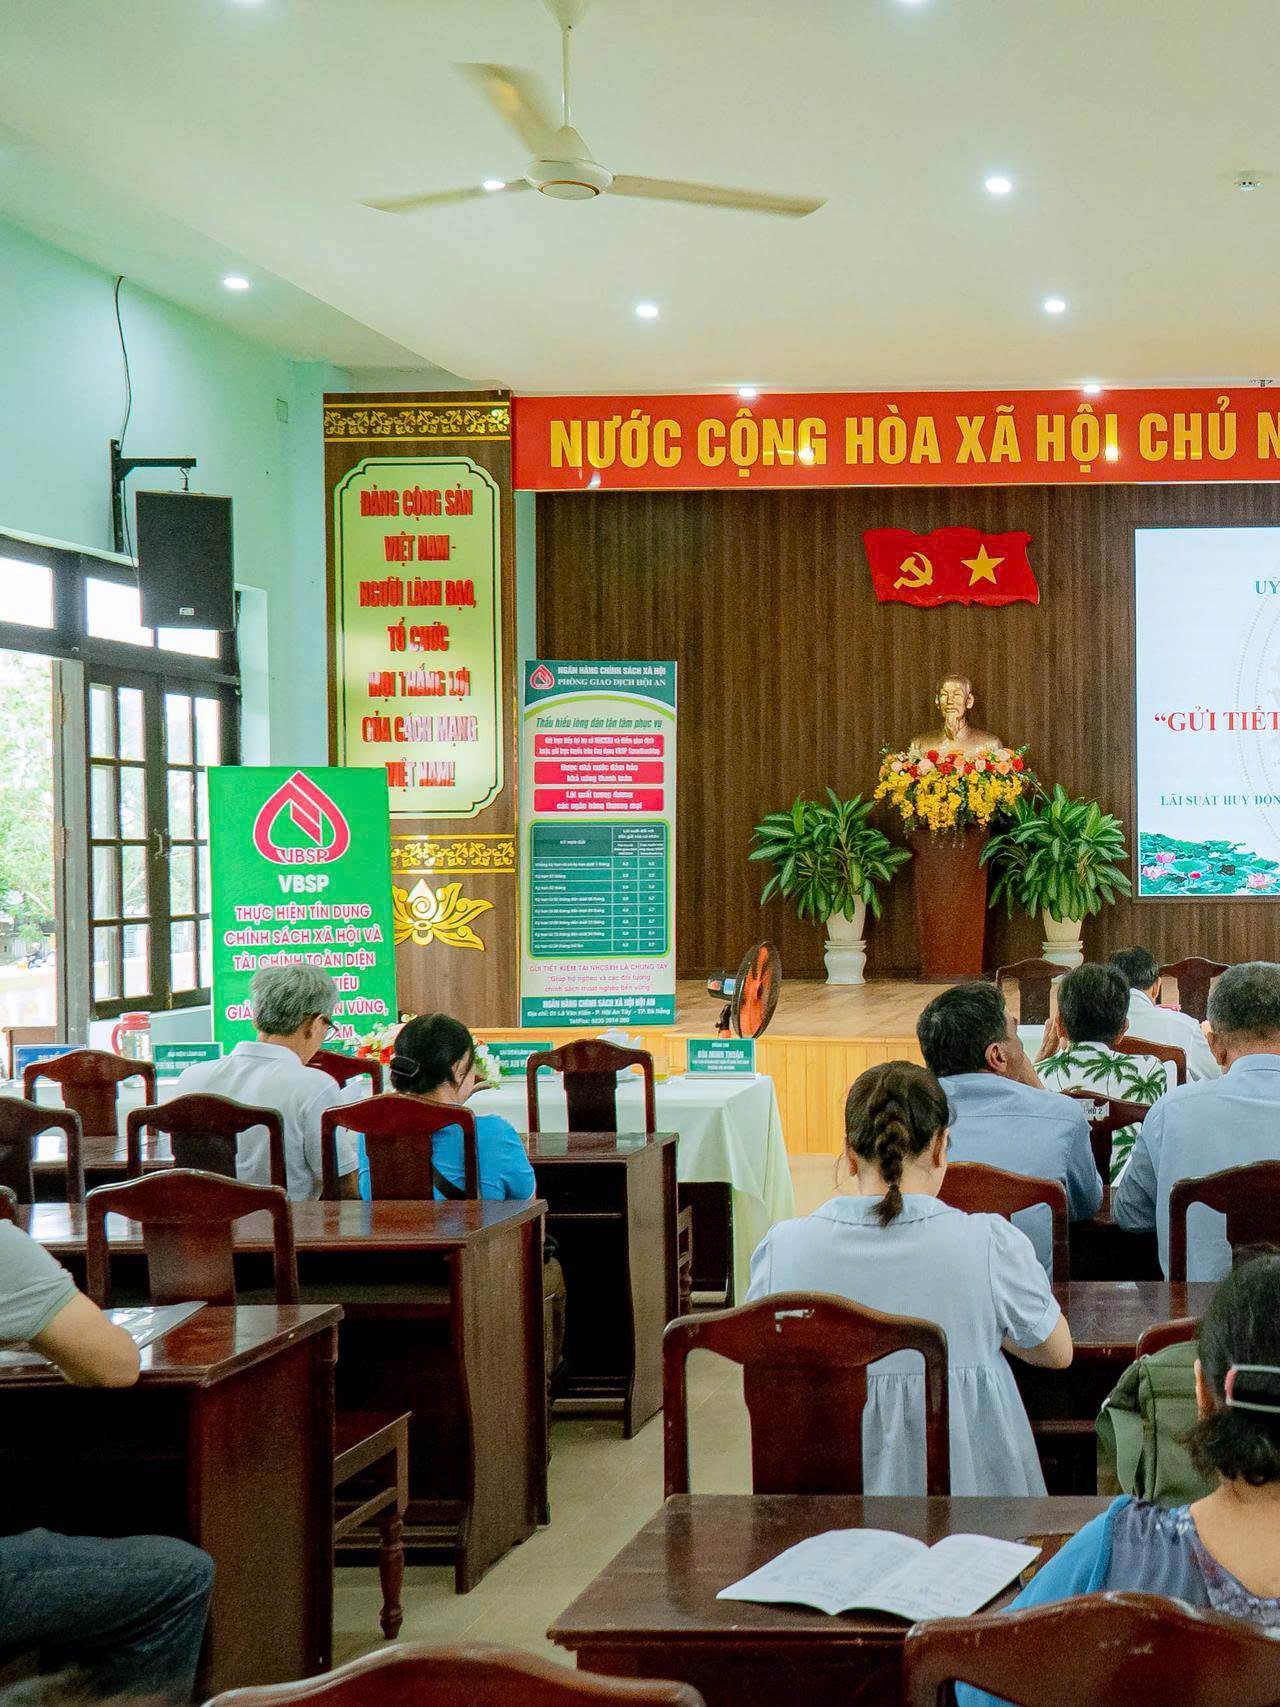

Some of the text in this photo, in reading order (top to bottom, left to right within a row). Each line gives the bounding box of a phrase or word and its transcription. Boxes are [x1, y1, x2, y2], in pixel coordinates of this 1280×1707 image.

[550, 410, 682, 468] NƯỚC
[697, 407, 828, 478] CỘNG
[845, 403, 941, 465] HÒA
[955, 404, 1022, 464] XÃ
[1037, 404, 1120, 473] HỘI
[1139, 395, 1236, 462] CHỦ
[402, 485, 442, 521] CỘNG
[445, 483, 473, 516] SẢN
[384, 531, 450, 567] VIỆT NAM
[359, 576, 403, 607] NGƯỜI
[406, 576, 442, 606] LÃNH
[557, 677, 588, 686] PHÒNG
[589, 678, 612, 686] GIAO
[654, 678, 666, 686] AN
[361, 710, 392, 743] CỦA
[1160, 792, 1183, 806] LÃI
[1223, 795, 1249, 806] HUY
[278, 873, 330, 894] VBSP
[234, 901, 371, 926] THỰC HIỆN TÍN DỤNG
[224, 924, 383, 947] CHÍNH SÁCH XÃ HỘI VÀ
[234, 948, 376, 971] TÀI CHÍNH TOÀN DIỆN
[226, 999, 256, 1021] GIẢ
